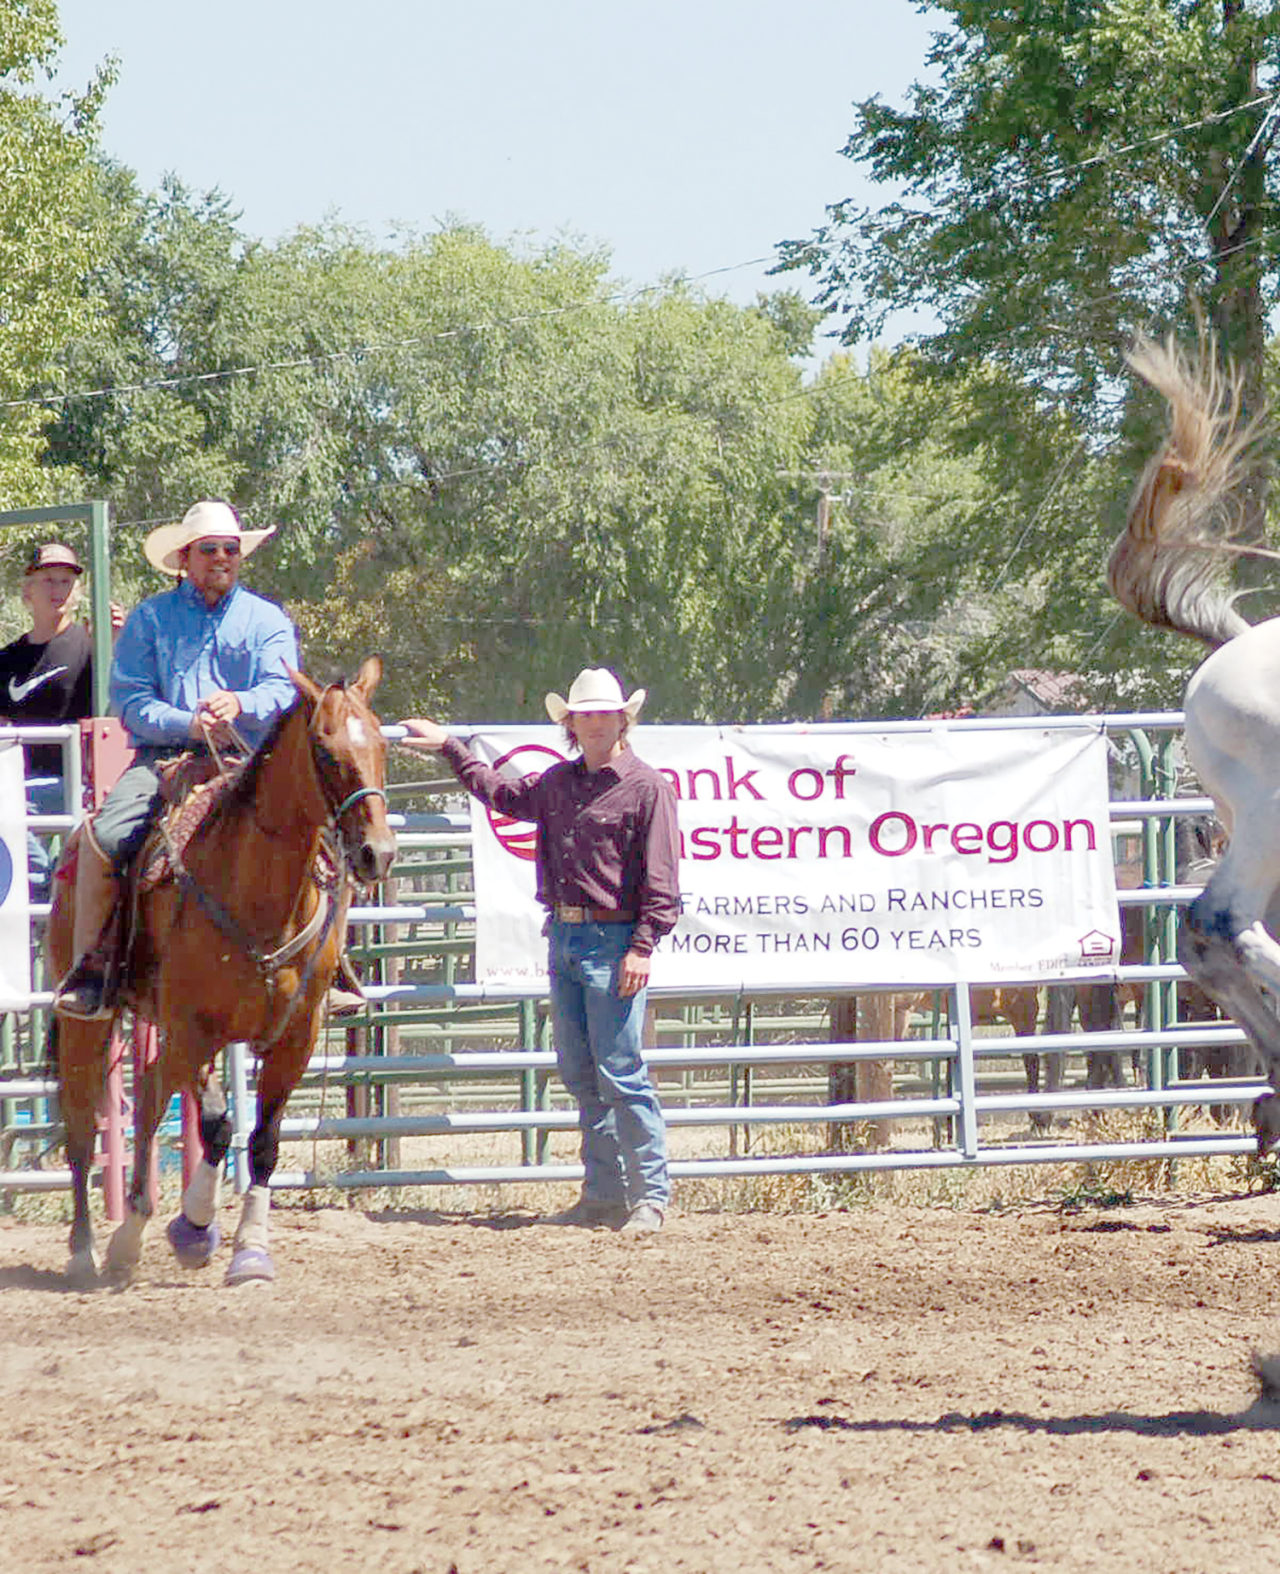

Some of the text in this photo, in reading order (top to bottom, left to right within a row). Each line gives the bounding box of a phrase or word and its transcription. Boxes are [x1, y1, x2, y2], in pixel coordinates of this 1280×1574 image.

[657, 754, 857, 801] ank of
[680, 811, 1097, 864] stern Oregon
[680, 887, 1044, 916] FARMERS AND RANCHERS
[671, 933, 749, 954] MORE
[755, 932, 831, 952] THAN
[840, 926, 880, 951] 60
[889, 928, 982, 950] YEARS
